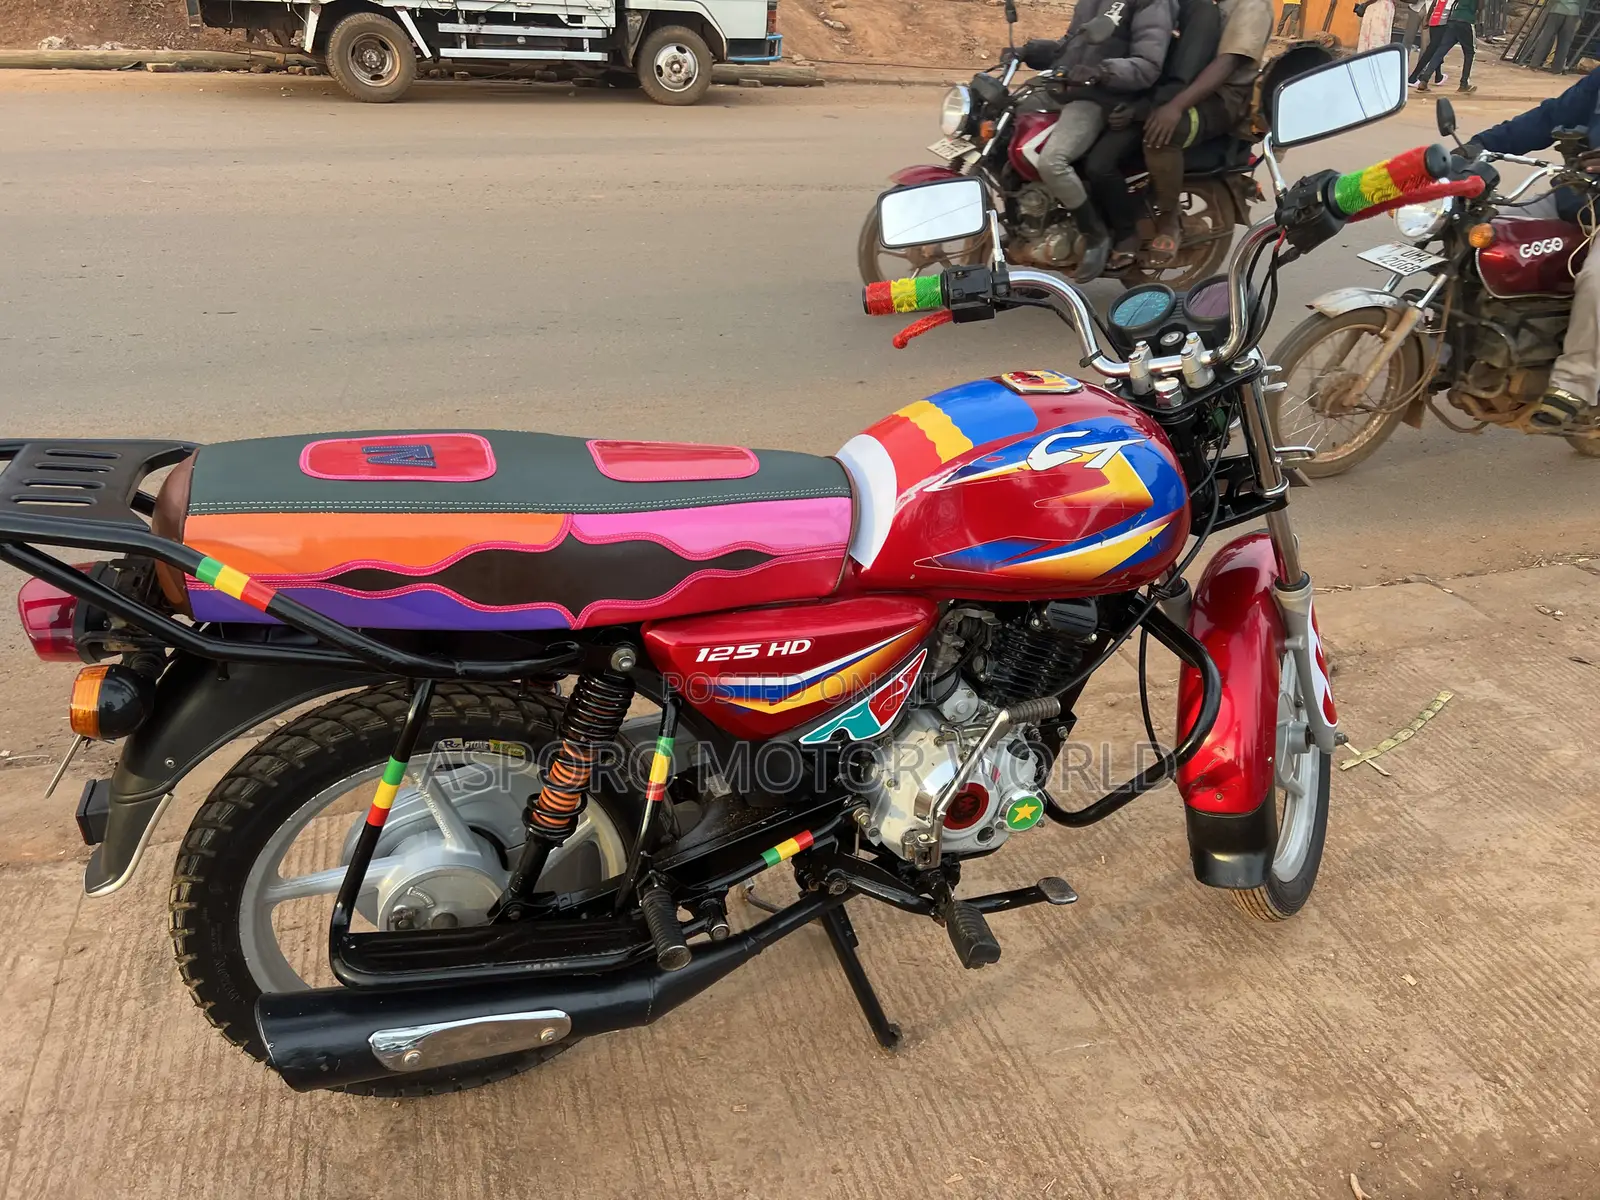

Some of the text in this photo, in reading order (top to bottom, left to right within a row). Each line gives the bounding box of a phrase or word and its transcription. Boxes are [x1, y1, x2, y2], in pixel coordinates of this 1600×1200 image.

[1519, 236, 1564, 258] GOGO
[695, 639, 812, 662] 125 HD
